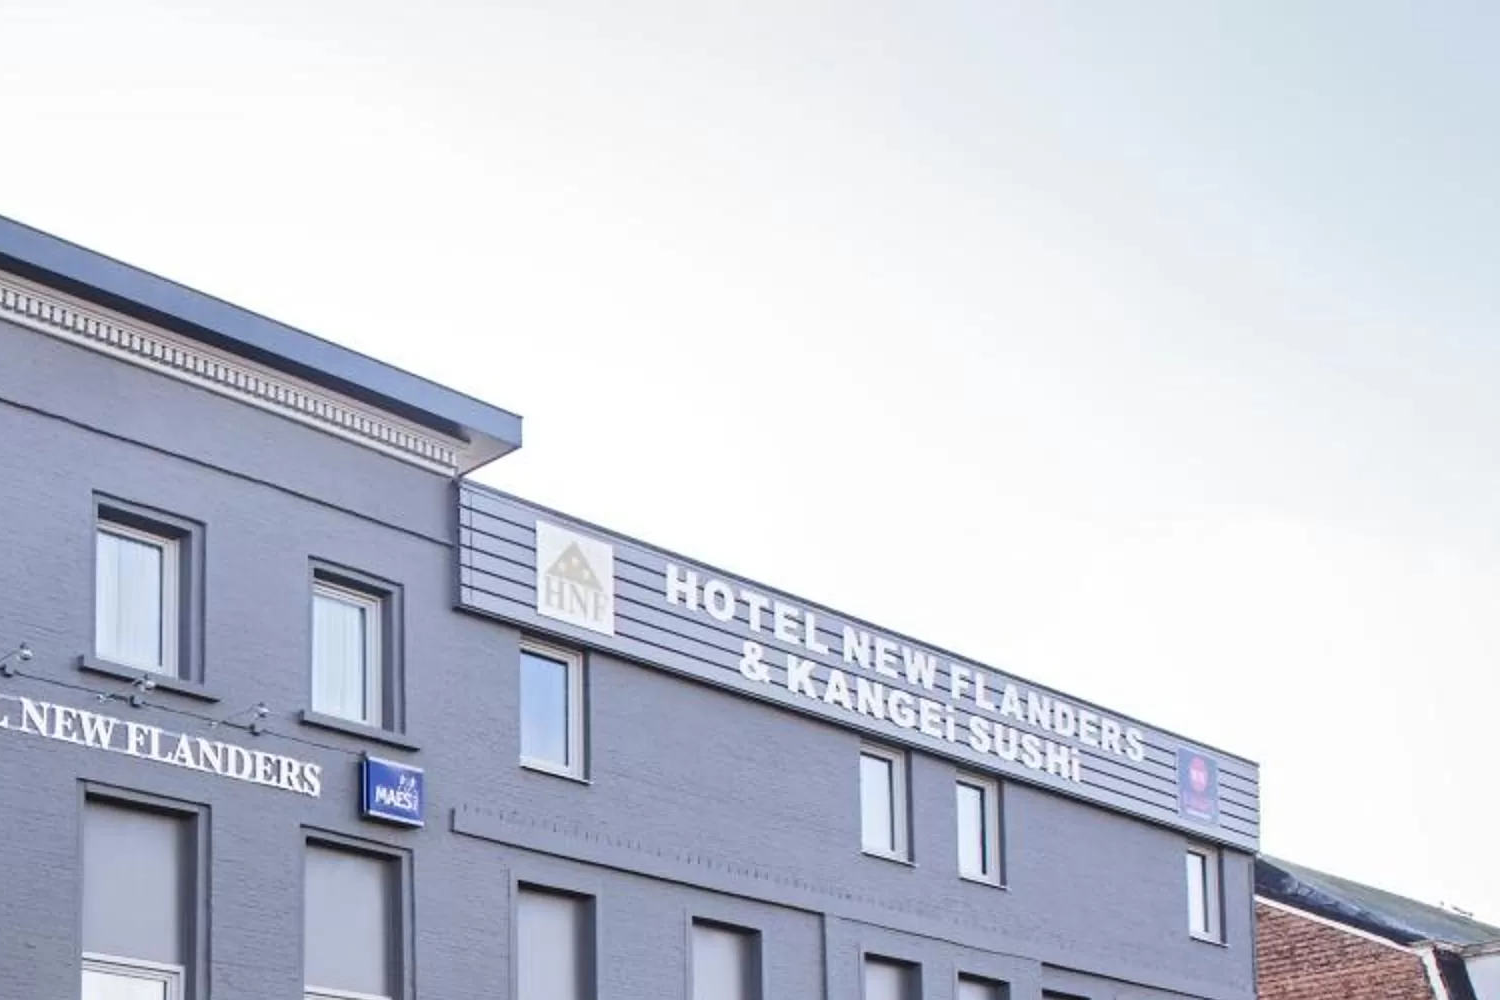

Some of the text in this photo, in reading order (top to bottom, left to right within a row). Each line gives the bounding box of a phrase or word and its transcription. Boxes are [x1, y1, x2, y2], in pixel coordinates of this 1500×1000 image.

[665, 562, 1146, 763] HOTEL NEW FLANDERS
[739, 640, 770, 684] &
[18, 696, 118, 751] NEW
[125, 720, 323, 798] FLANDERS
[374, 784, 413, 810] MAES
